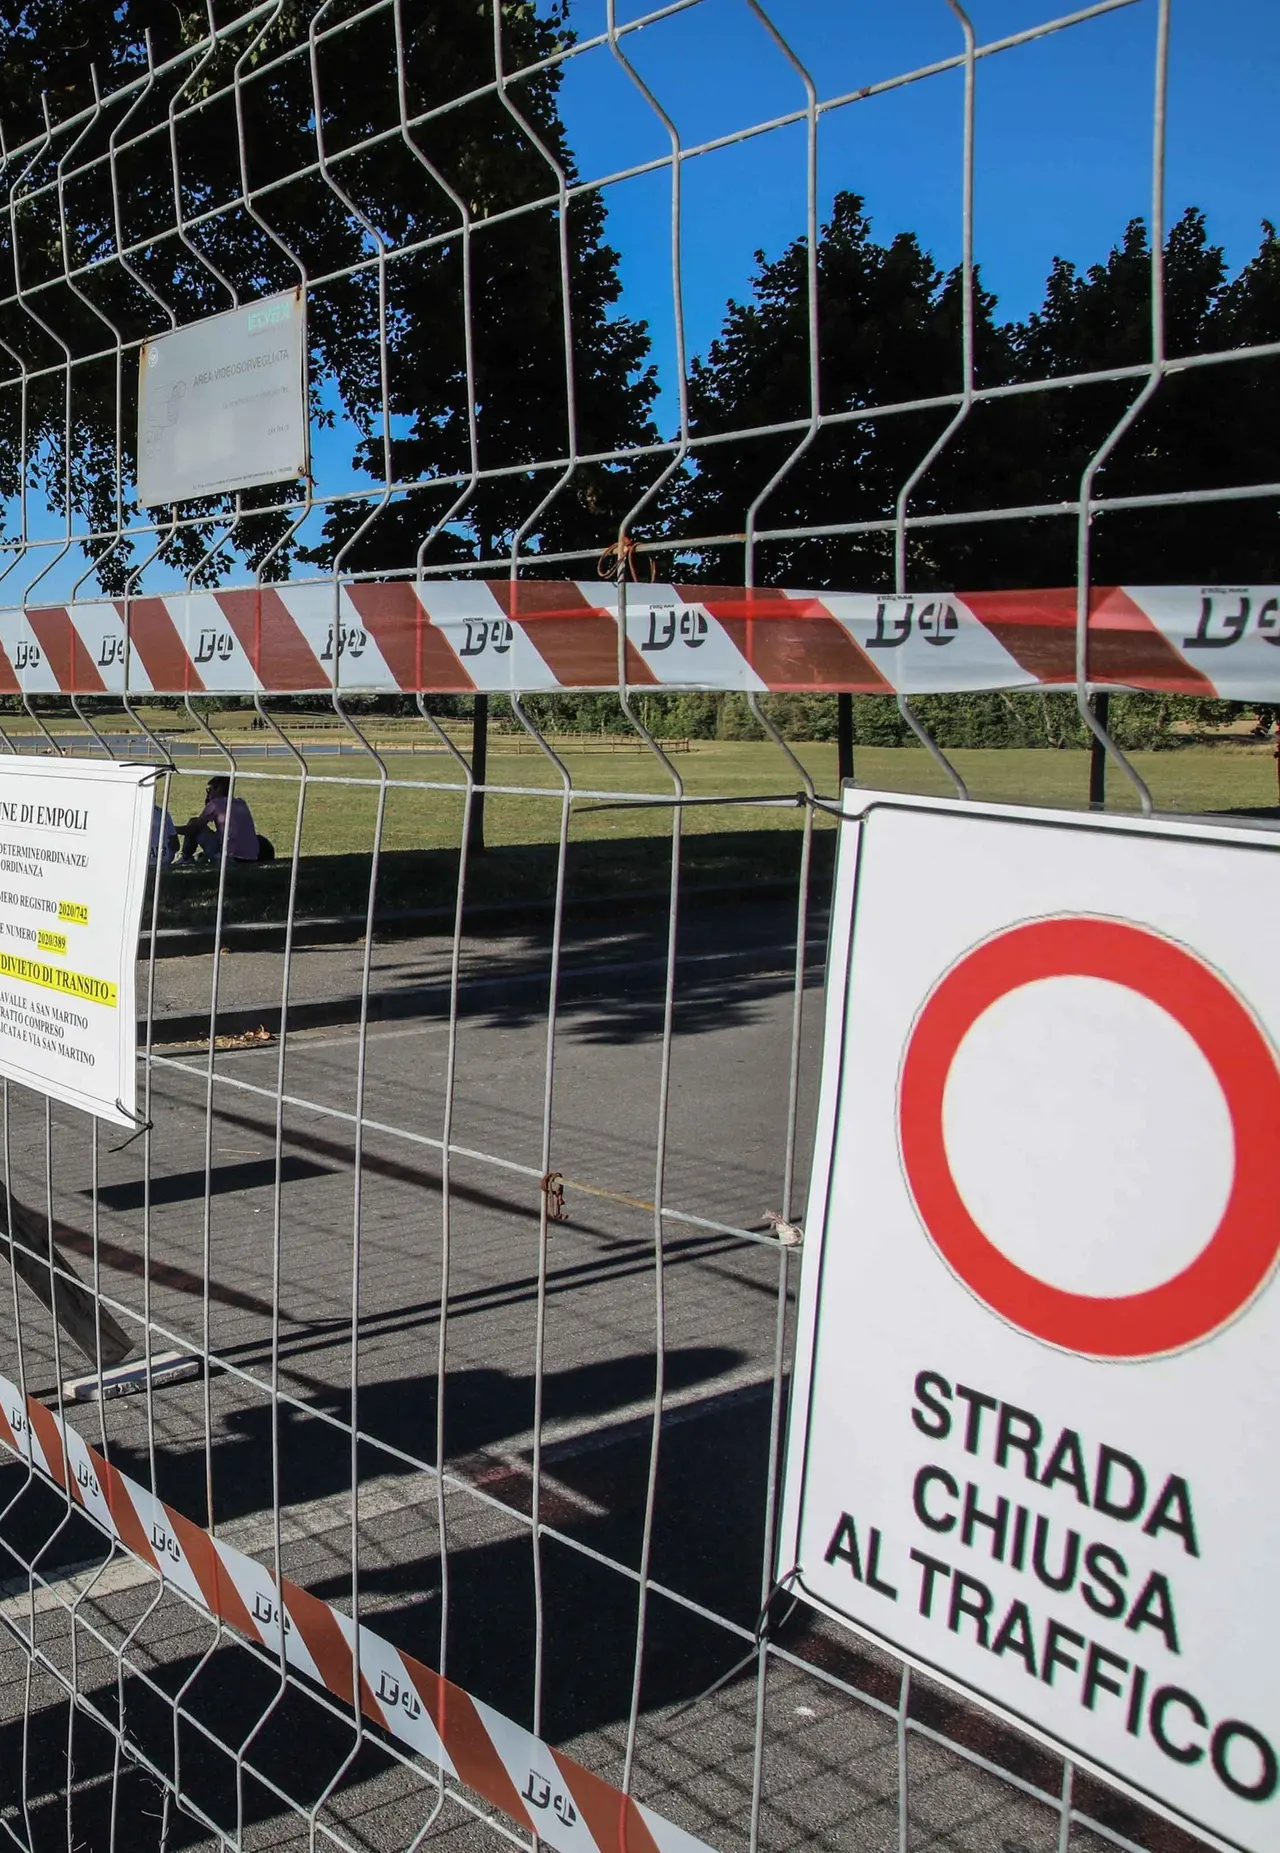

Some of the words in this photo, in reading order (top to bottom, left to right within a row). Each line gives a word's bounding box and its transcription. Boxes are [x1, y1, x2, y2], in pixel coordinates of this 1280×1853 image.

[193, 371, 213, 387] AREA
[20, 804, 33, 823] DI
[37, 806, 88, 830] EMPOLI
[0, 859, 43, 878] ORDINANZA
[20, 895, 57, 914] REGISTRO
[58, 902, 88, 920] 2020/742
[0, 922, 5, 933] E
[6, 924, 37, 942] NUMERO
[38, 930, 66, 949] 2020/389
[1, 955, 40, 979] DIVIETO
[42, 965, 53, 983] DI
[55, 970, 109, 1000] TRANSITO
[24, 1012, 64, 1039] COMPRESO
[30, 999, 36, 1013] A
[37, 1001, 50, 1016] SAN
[53, 1007, 88, 1030] MARTINO
[23, 1029, 28, 1041] E
[29, 1031, 41, 1046] VIA
[42, 1036, 56, 1051] SAN
[58, 1042, 95, 1066] MARTINO
[911, 1369, 1200, 1559] STRADA
[912, 1463, 1181, 1656] CHIUSA
[823, 1511, 898, 1603] AL
[909, 1546, 1280, 1804] TRAFFICO
